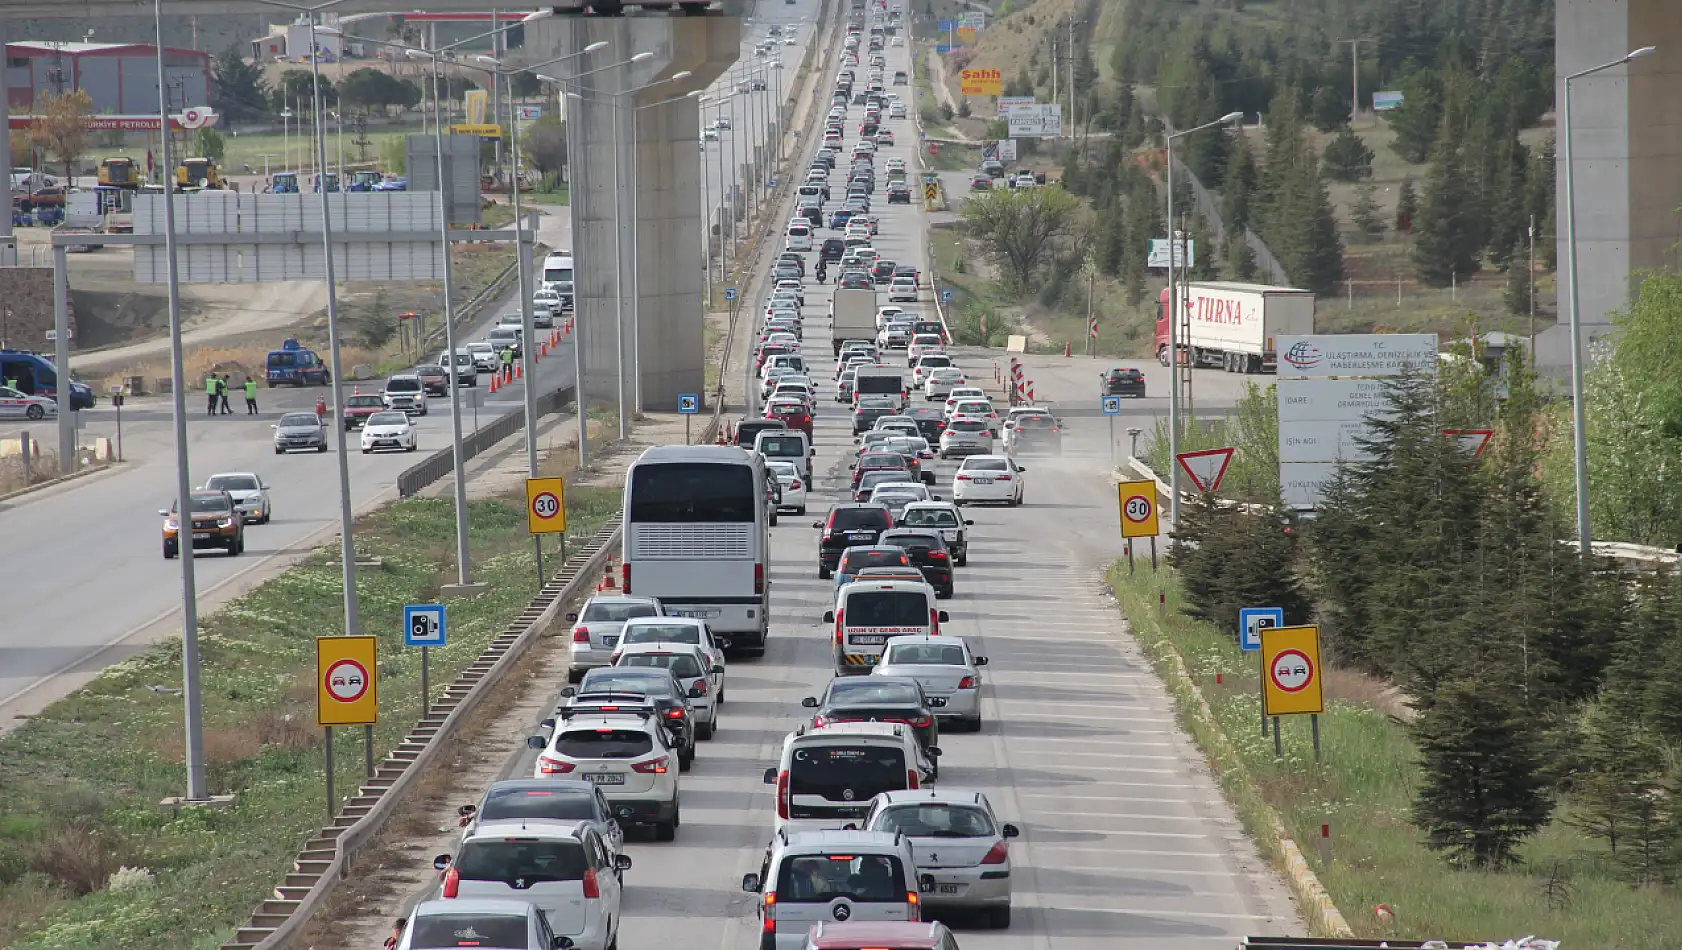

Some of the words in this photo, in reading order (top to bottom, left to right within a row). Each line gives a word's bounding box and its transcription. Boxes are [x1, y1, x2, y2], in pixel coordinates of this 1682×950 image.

[1197, 296, 1242, 325] TURNA
[537, 499, 555, 513] 30
[1129, 501, 1147, 515] 30
